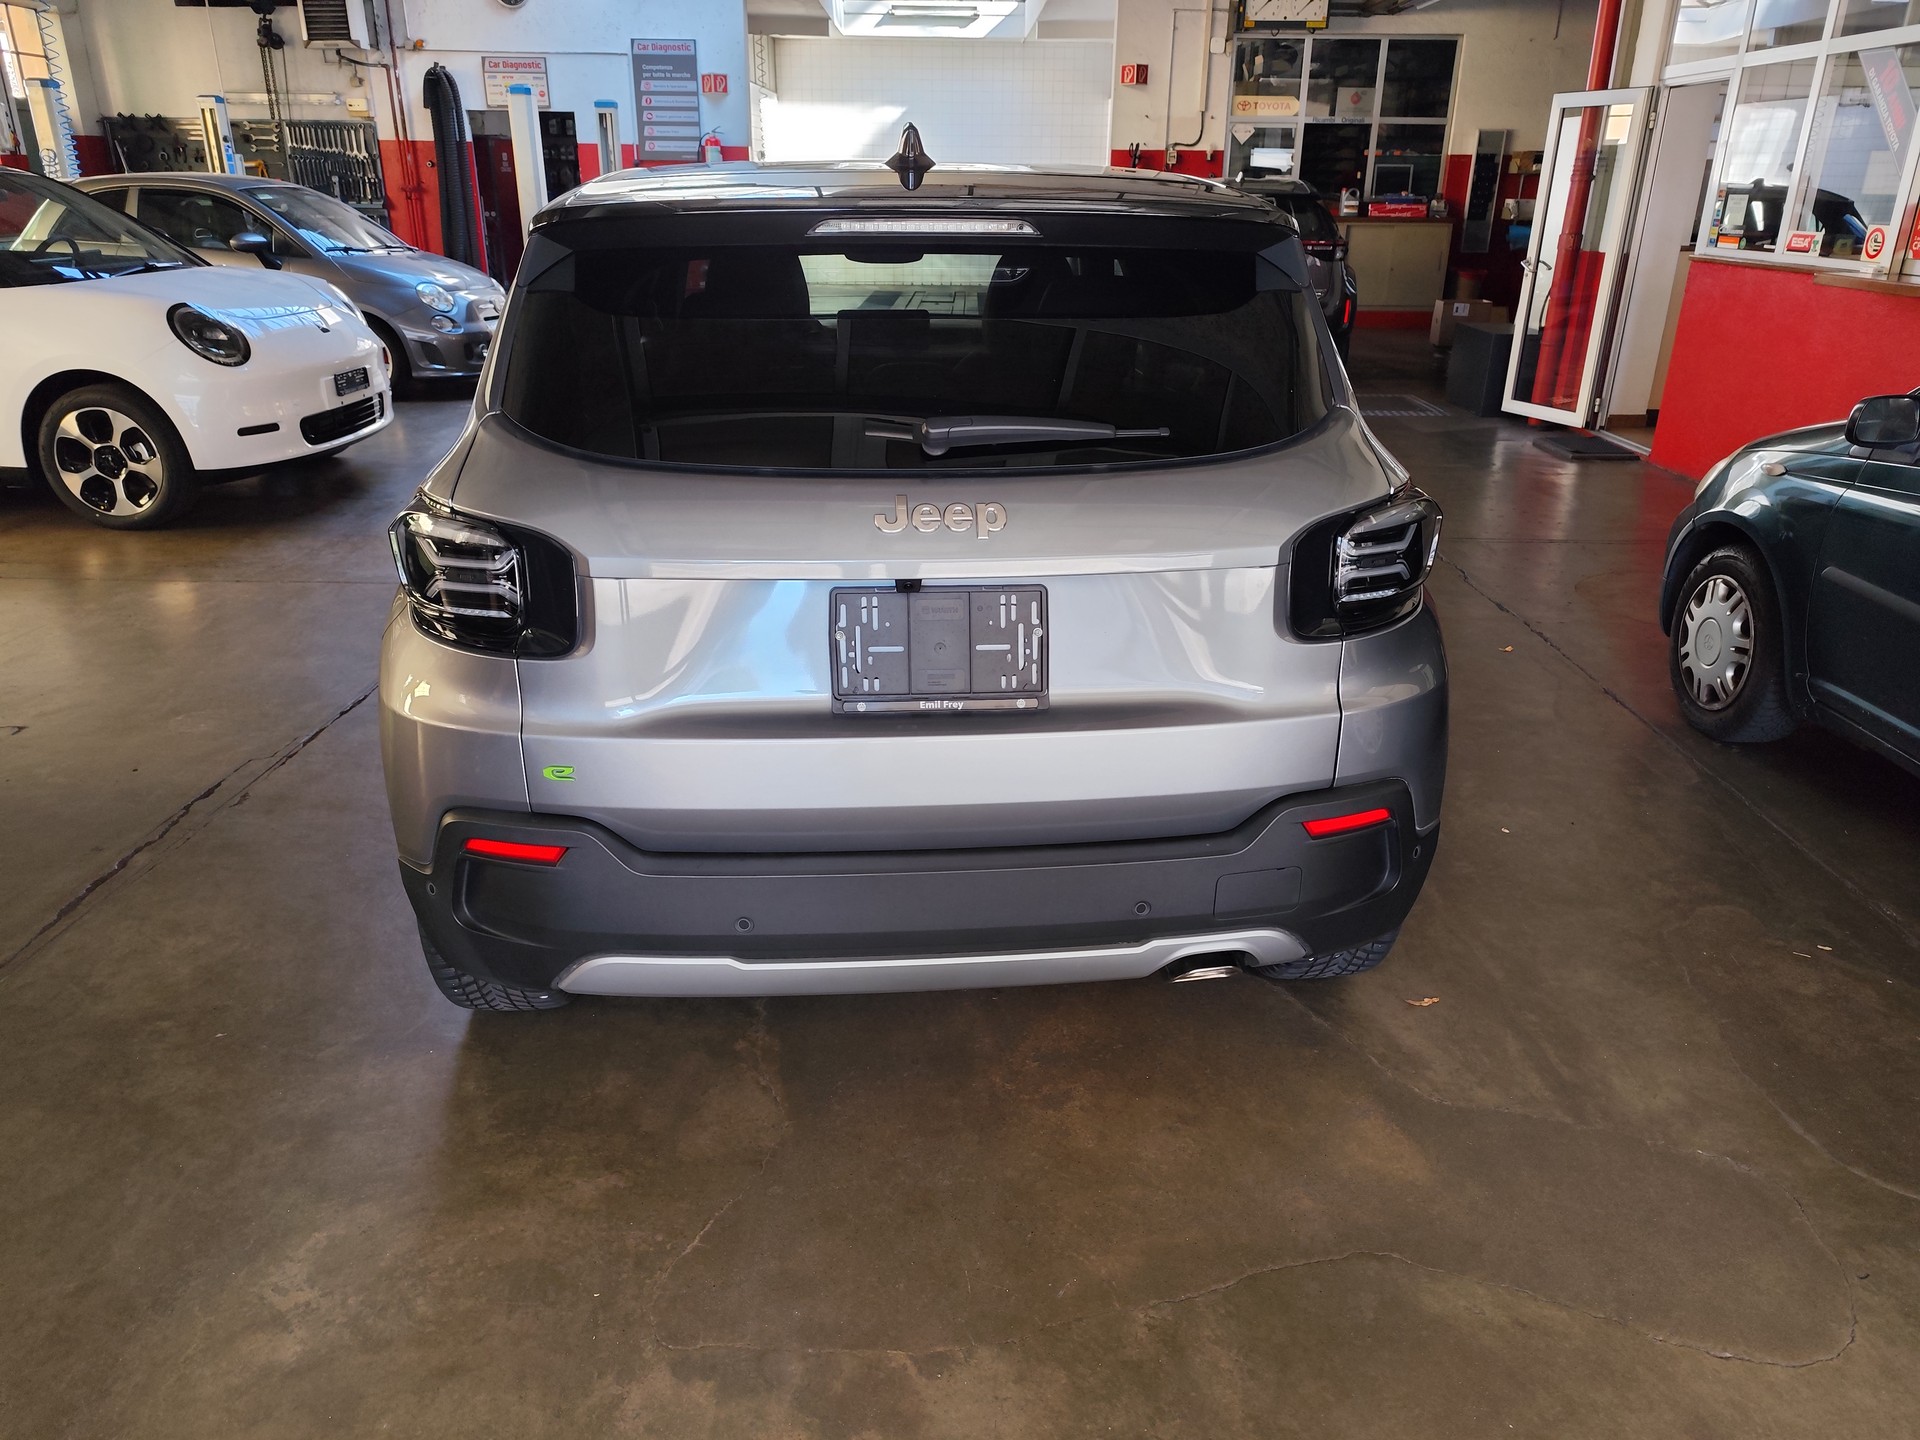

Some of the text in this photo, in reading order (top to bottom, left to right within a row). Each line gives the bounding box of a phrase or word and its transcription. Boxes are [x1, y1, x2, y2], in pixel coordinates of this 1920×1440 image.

[637, 41, 692, 53] Car Diagnostic
[488, 59, 542, 71] Car Diagnostic
[1253, 102, 1290, 110] TOYOTA
[1872, 77, 1889, 120] GARANZIA
[1885, 119, 1900, 152] TOYOTA
[873, 494, 1007, 540] Jeep
[919, 700, 964, 711] Emil Frey
